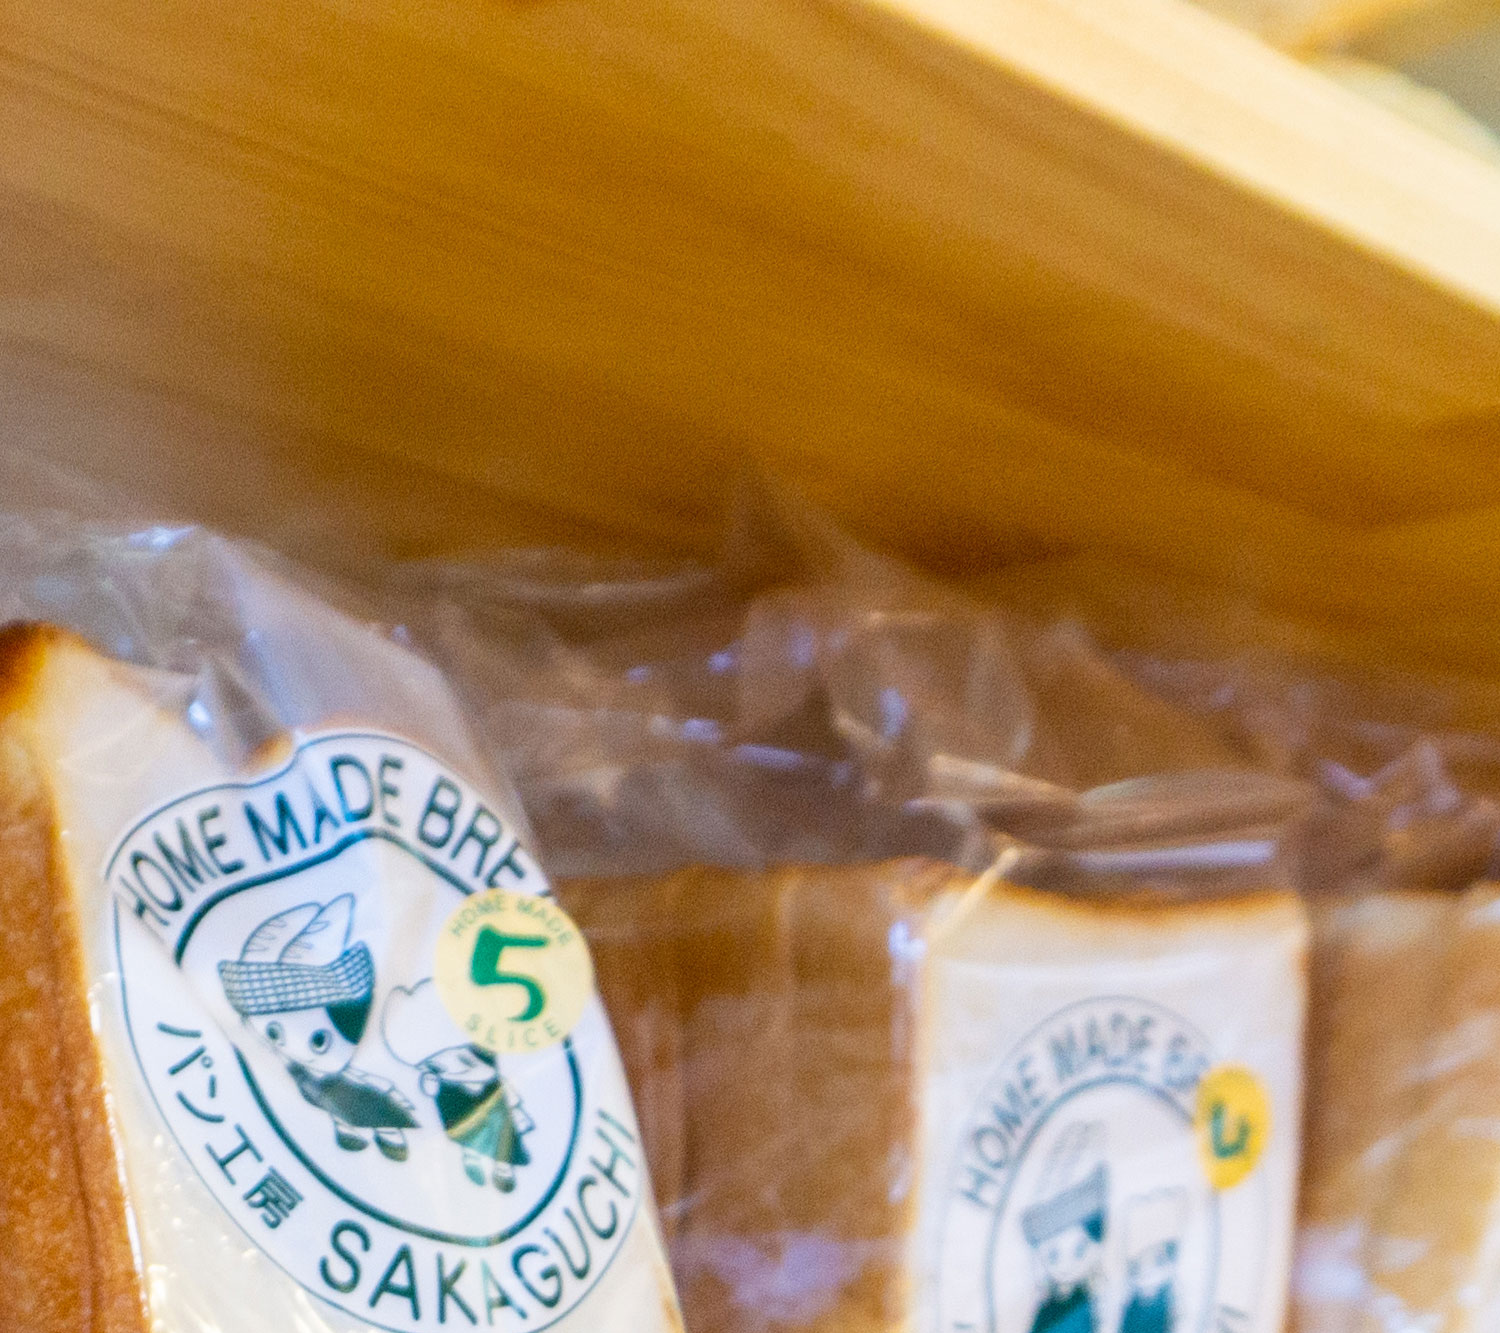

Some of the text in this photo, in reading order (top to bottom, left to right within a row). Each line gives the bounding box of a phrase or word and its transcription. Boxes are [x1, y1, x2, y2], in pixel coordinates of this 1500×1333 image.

[243, 753, 405, 862] MADE
[469, 923, 548, 1023] 5
[156, 1022, 638, 1327] パン工房 SAKAGUCHI
